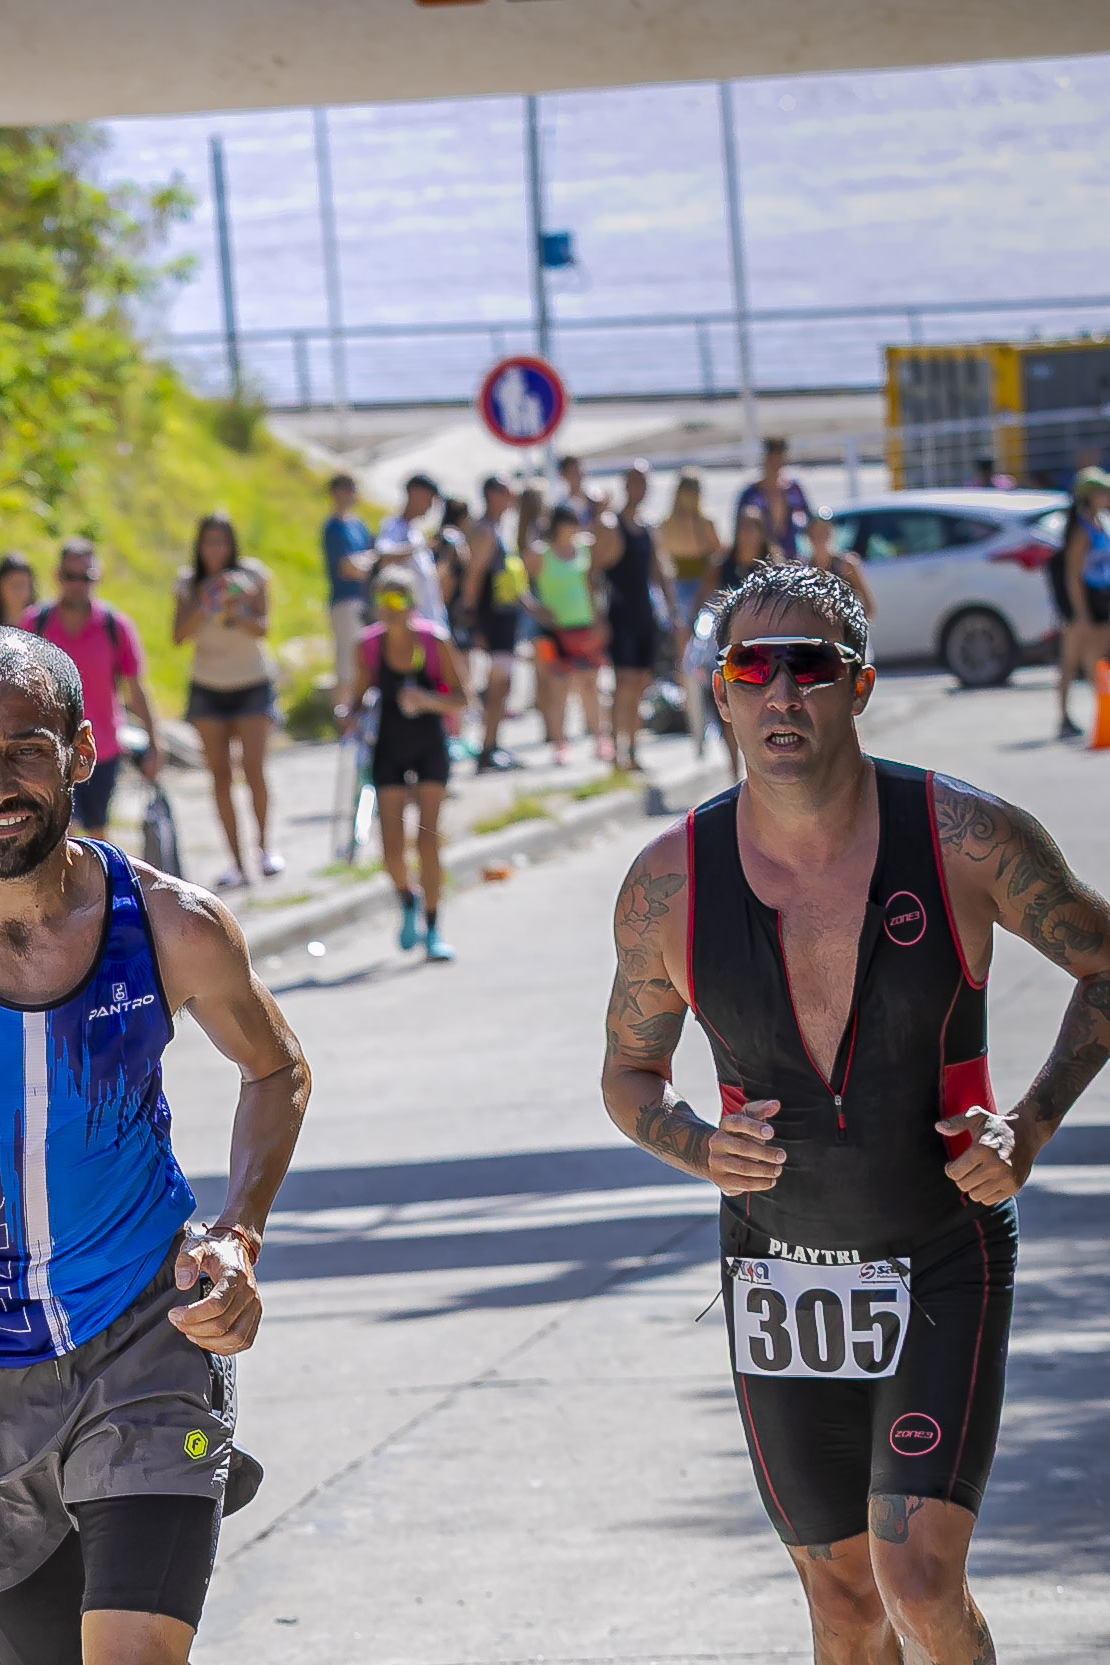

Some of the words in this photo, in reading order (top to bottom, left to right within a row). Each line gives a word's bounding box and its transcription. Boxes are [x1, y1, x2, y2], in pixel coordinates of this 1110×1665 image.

[88, 994, 155, 1021] PANTRO
[768, 1237, 861, 1264] PLAYTRI
[746, 1288, 902, 1374] 305
